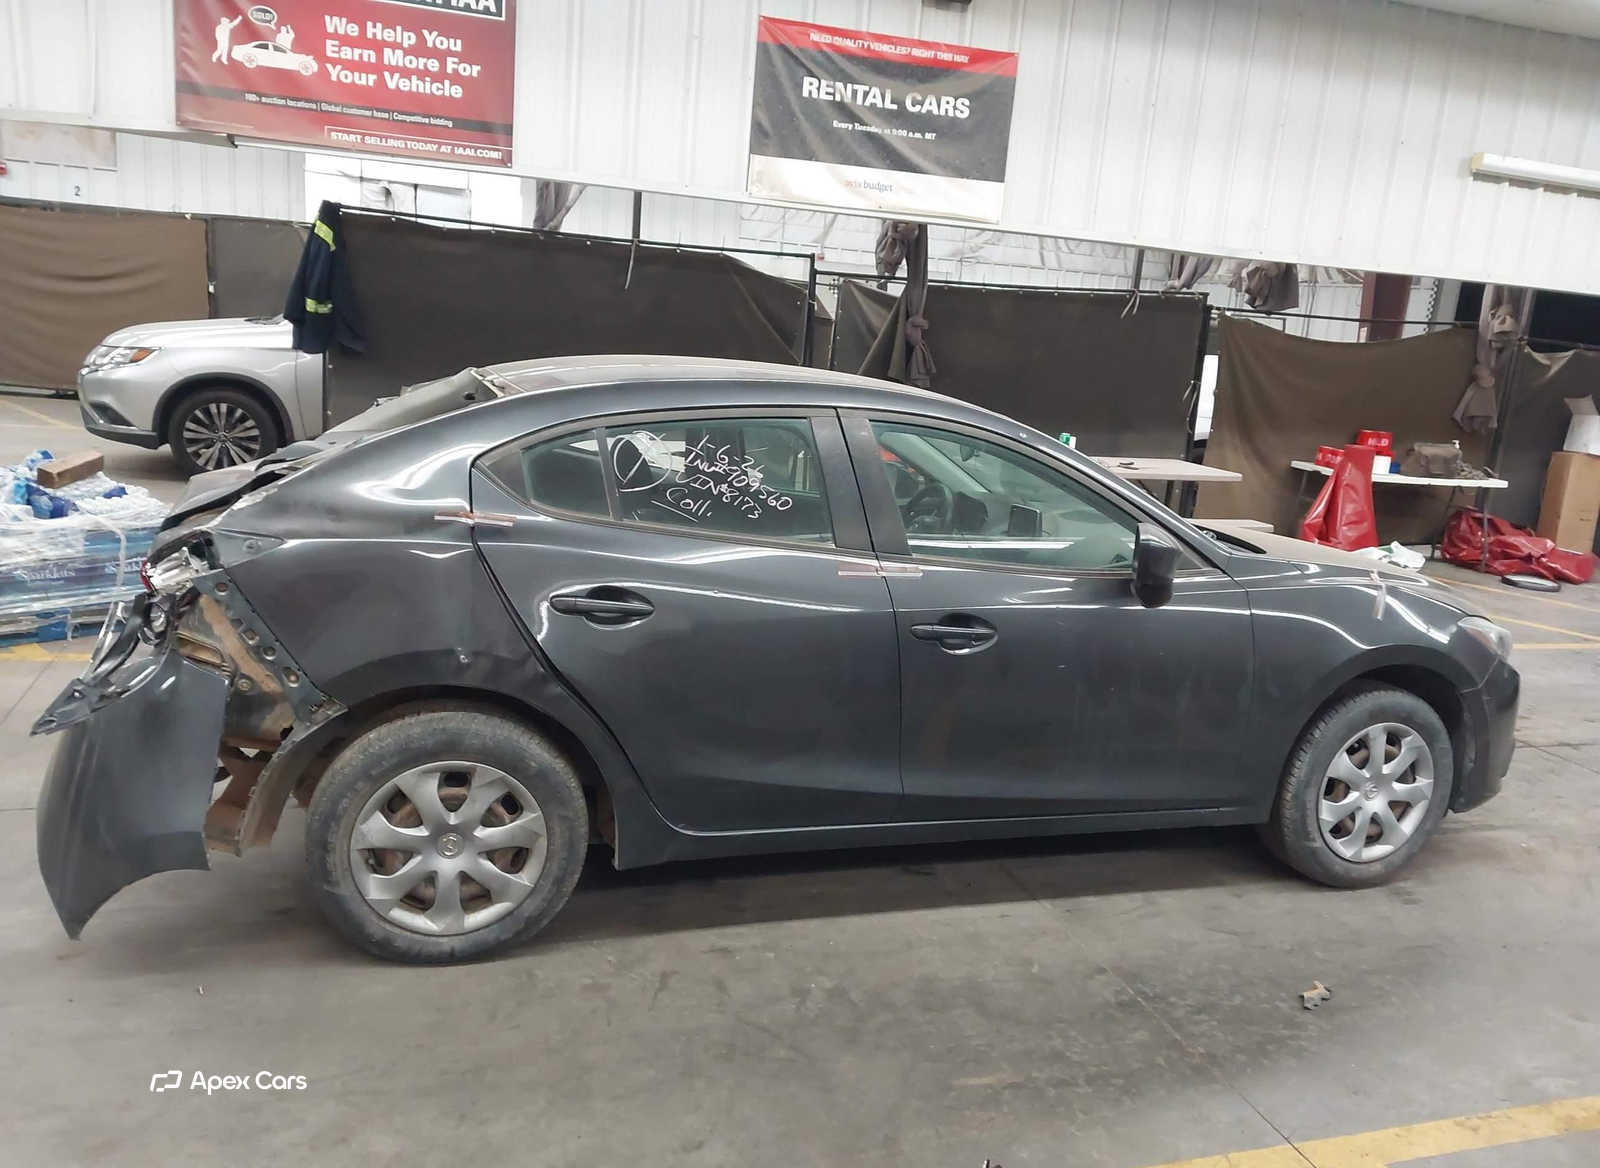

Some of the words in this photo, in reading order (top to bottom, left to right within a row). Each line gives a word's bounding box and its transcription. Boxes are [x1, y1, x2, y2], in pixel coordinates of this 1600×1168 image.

[324, 14, 360, 37] We
[366, 21, 417, 48] Help
[421, 29, 462, 52] You
[809, 32, 832, 43] NEED
[833, 35, 869, 50] QUALITY
[869, 41, 910, 56] VEHICLES?
[911, 48, 936, 60] RIGHT
[936, 50, 953, 62] THIS
[953, 53, 969, 64] WAY
[325, 39, 376, 63] Earn
[383, 48, 440, 72] More
[446, 56, 482, 77] For
[325, 63, 377, 87] Your
[383, 71, 463, 98] Vehicle
[802, 76, 898, 110] RENTAL
[905, 91, 970, 119] CARS
[286, 99, 317, 110] locations
[321, 102, 342, 113] Global
[342, 106, 372, 116] customer
[373, 109, 389, 119] base
[393, 112, 430, 124] Competitive
[430, 116, 453, 128] bidding
[832, 119, 853, 131] Every
[853, 122, 882, 135] Tuesday
[908, 130, 923, 139] a.m.
[924, 132, 937, 140] MT
[330, 131, 363, 143] START
[364, 135, 405, 148] SELLING
[405, 140, 438, 153] TODAY
[439, 144, 453, 154] AT
[454, 146, 503, 160] IAAI.COM!
[74, 185, 81, 197] 2
[844, 179, 862, 189] avis
[863, 180, 893, 194] budget
